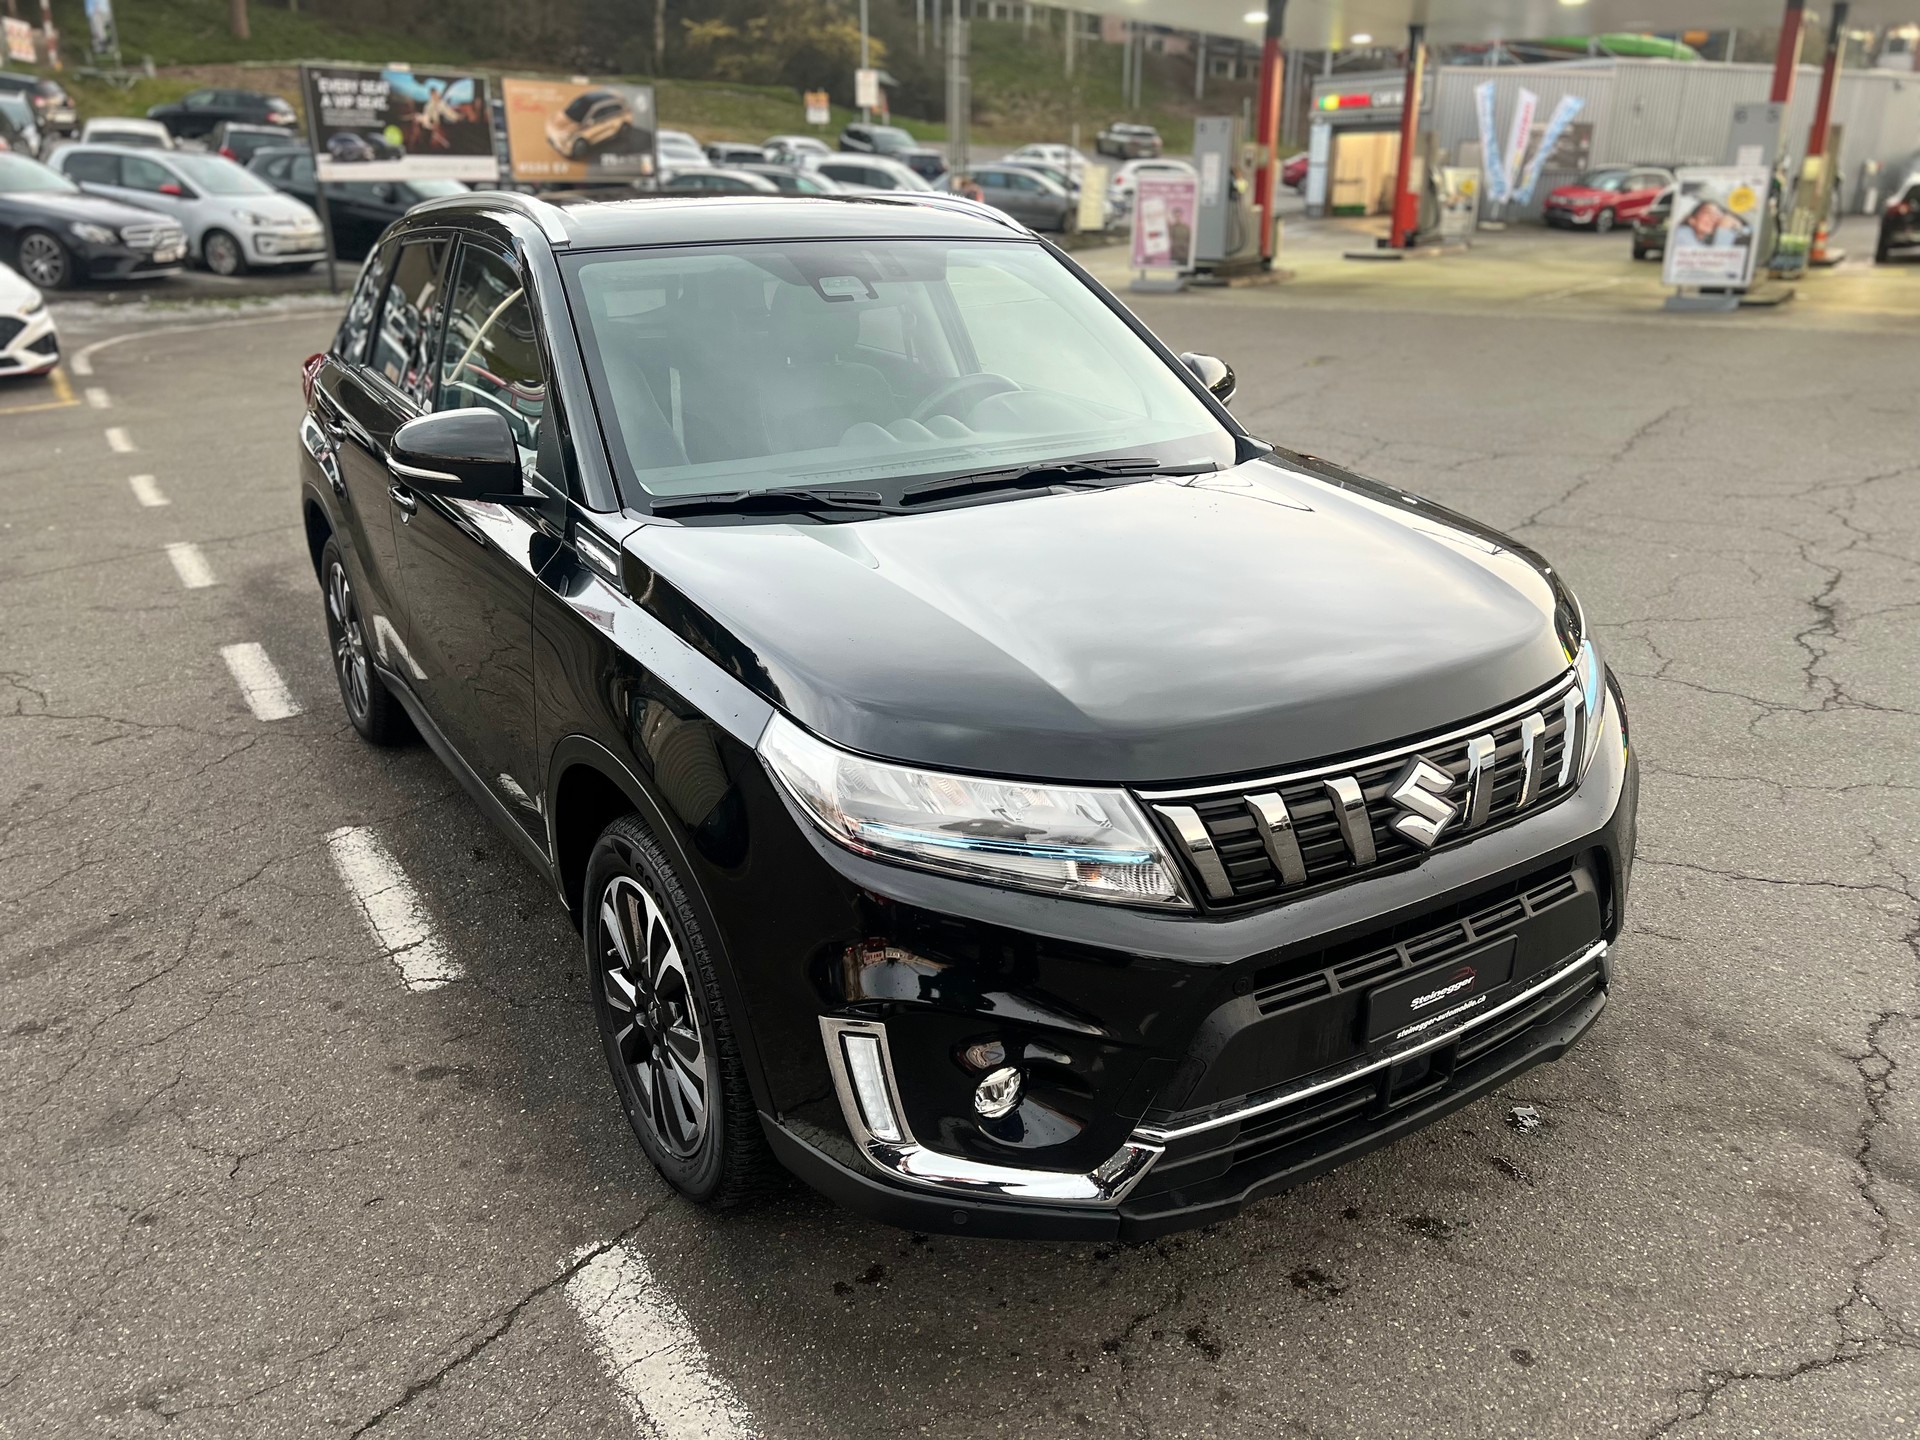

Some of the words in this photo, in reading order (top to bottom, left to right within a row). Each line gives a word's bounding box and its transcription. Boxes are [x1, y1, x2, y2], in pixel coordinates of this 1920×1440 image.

[360, 79, 390, 96] SEAT
[320, 93, 333, 108] A
[1410, 975, 1475, 1008] Steinegger
